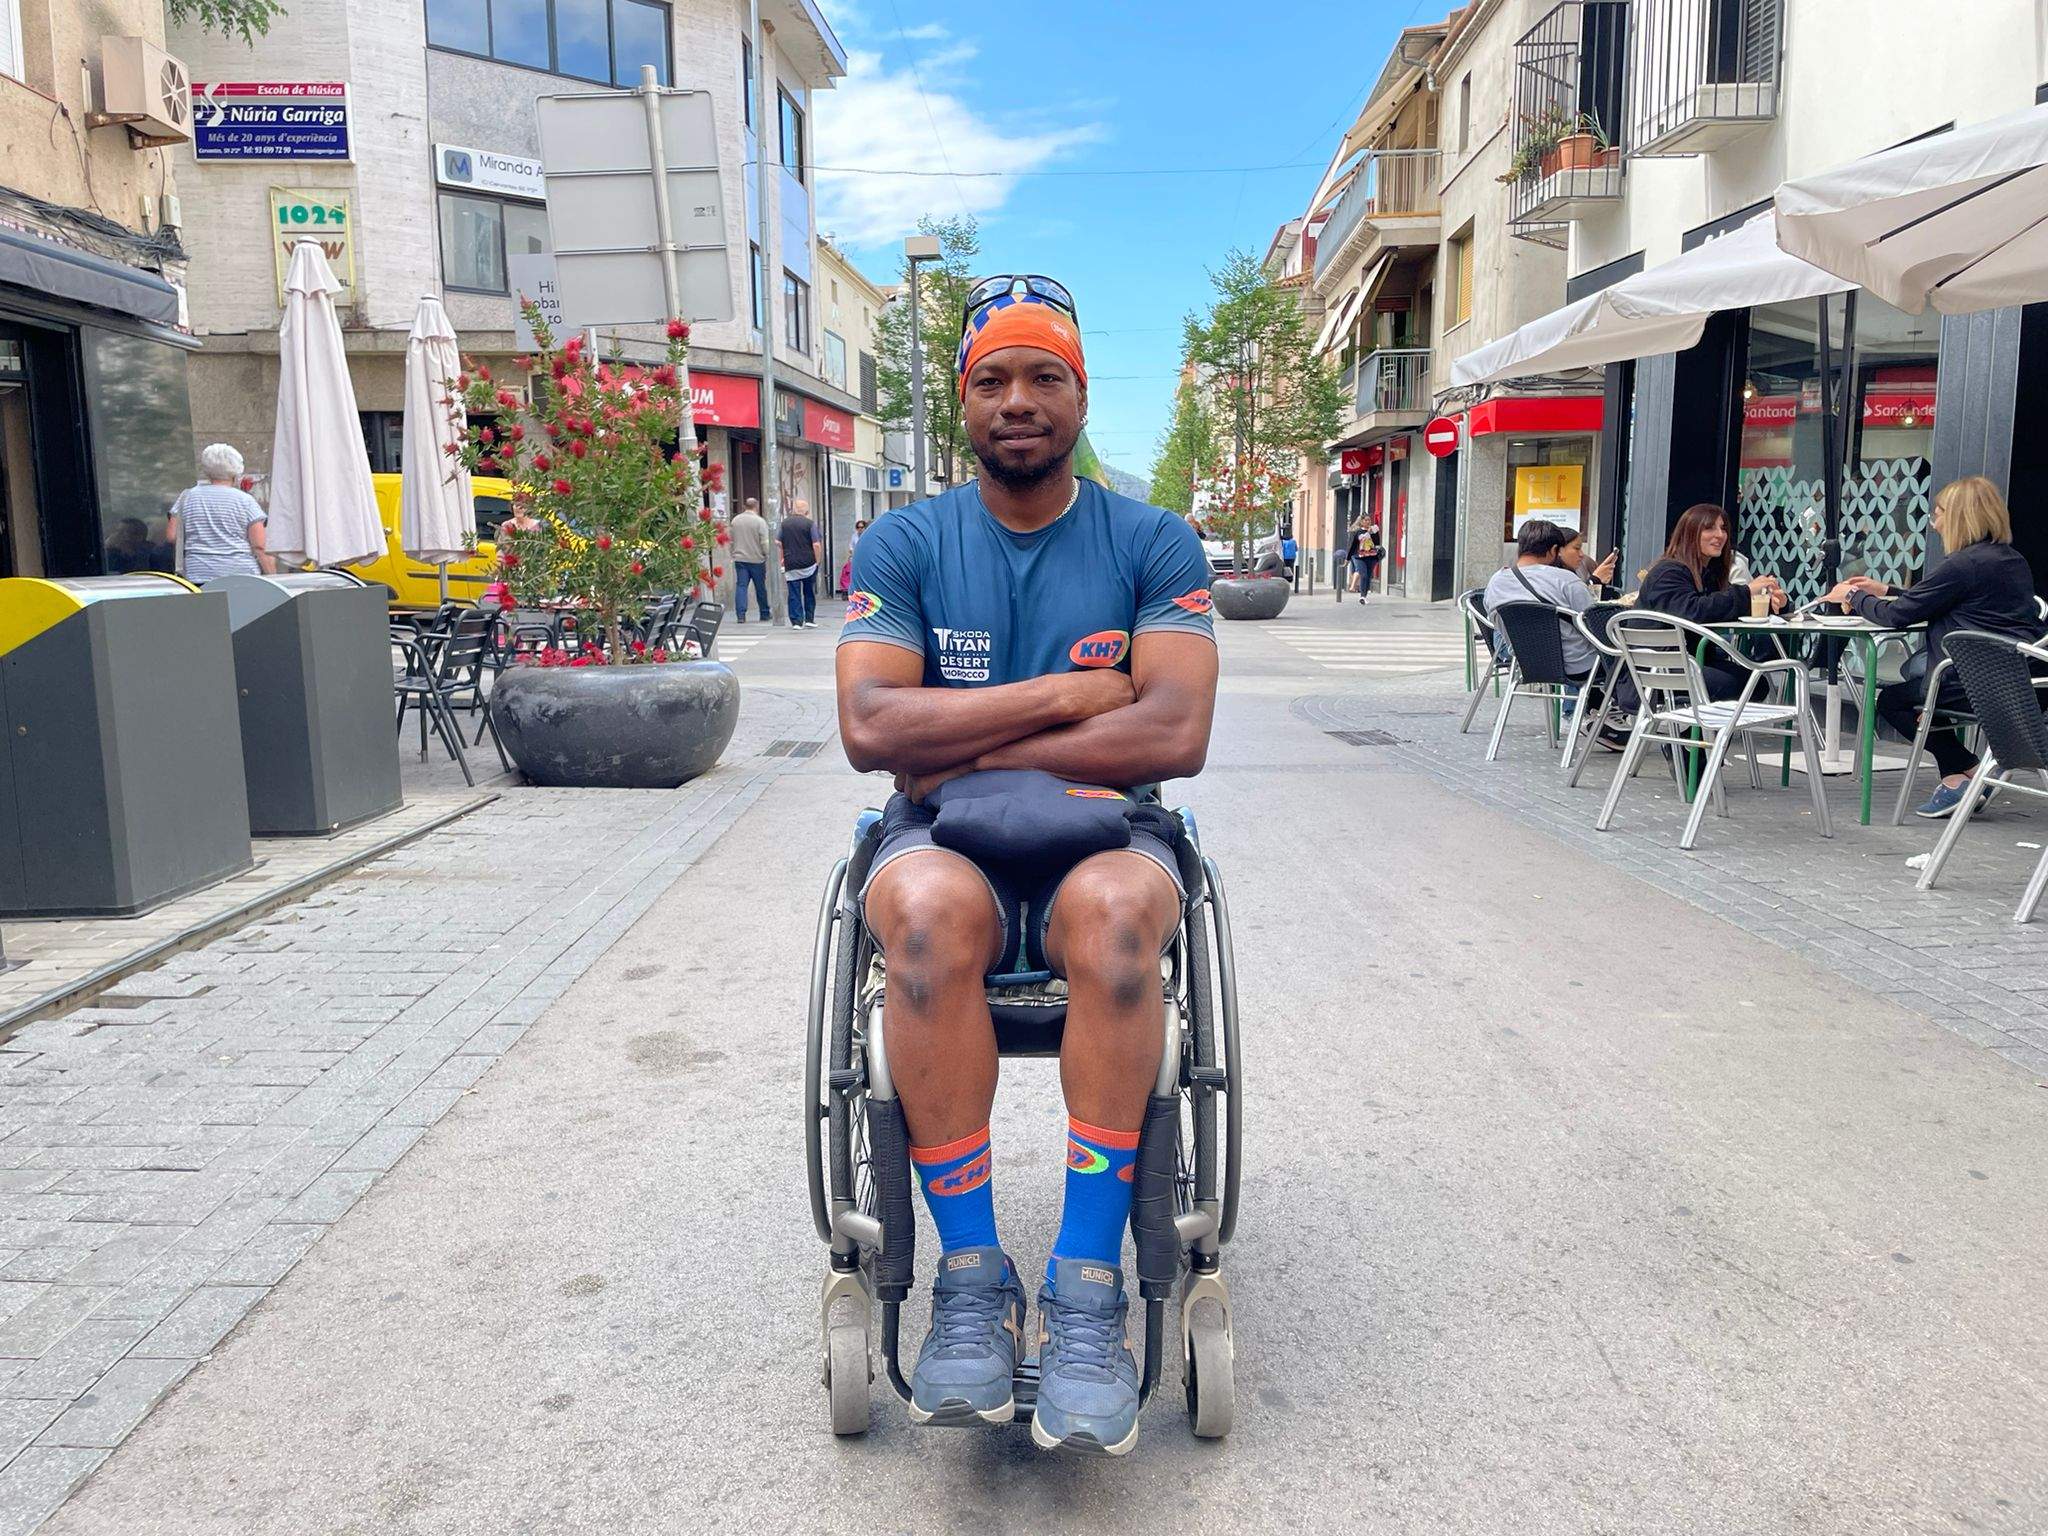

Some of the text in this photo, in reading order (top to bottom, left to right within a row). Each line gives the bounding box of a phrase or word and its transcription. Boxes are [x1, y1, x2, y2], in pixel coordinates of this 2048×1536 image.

[258, 85, 342, 95] Escola de Música
[230, 106, 344, 125] Núria Garriga
[208, 133, 225, 142] Més
[228, 133, 239, 142] de
[241, 133, 253, 142] 20
[255, 134, 275, 144] anys
[479, 154, 533, 177] Miranda
[278, 204, 346, 225] 1024
[538, 280, 555, 293] Hi
[932, 627, 990, 652] TITAN
[940, 655, 991, 668] DESERT
[944, 669, 985, 679] MOROCCO
[942, 1162, 991, 1190] KH
[948, 1255, 980, 1270] MUNICH
[1082, 1267, 1114, 1285] MUNICH
